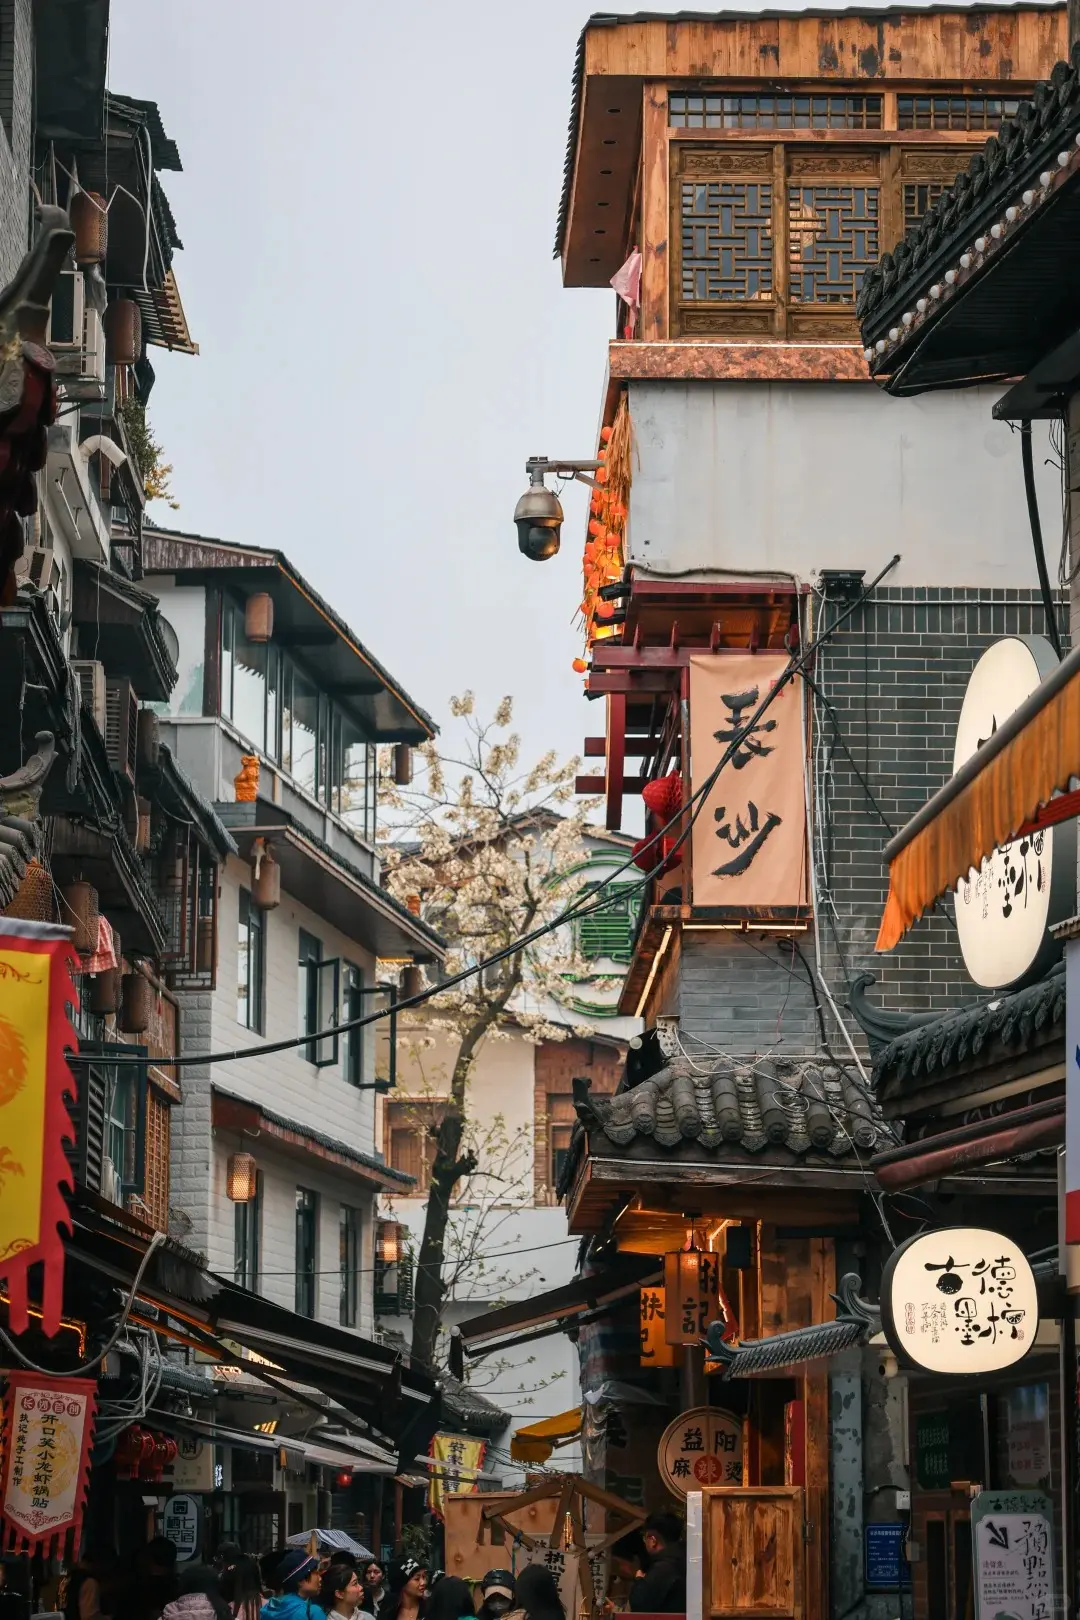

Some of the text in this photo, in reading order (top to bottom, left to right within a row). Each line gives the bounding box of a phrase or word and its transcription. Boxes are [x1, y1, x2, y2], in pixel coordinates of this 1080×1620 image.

[22, 1397, 81, 1416] 长沙首创
[12, 1413, 29, 1487] 扶记纯手工制作
[681, 1428, 737, 1454] 益阳
[29, 1414, 59, 1509] 开口笑小龙虾锅贴
[671, 1457, 743, 1482] 麻辣烫
